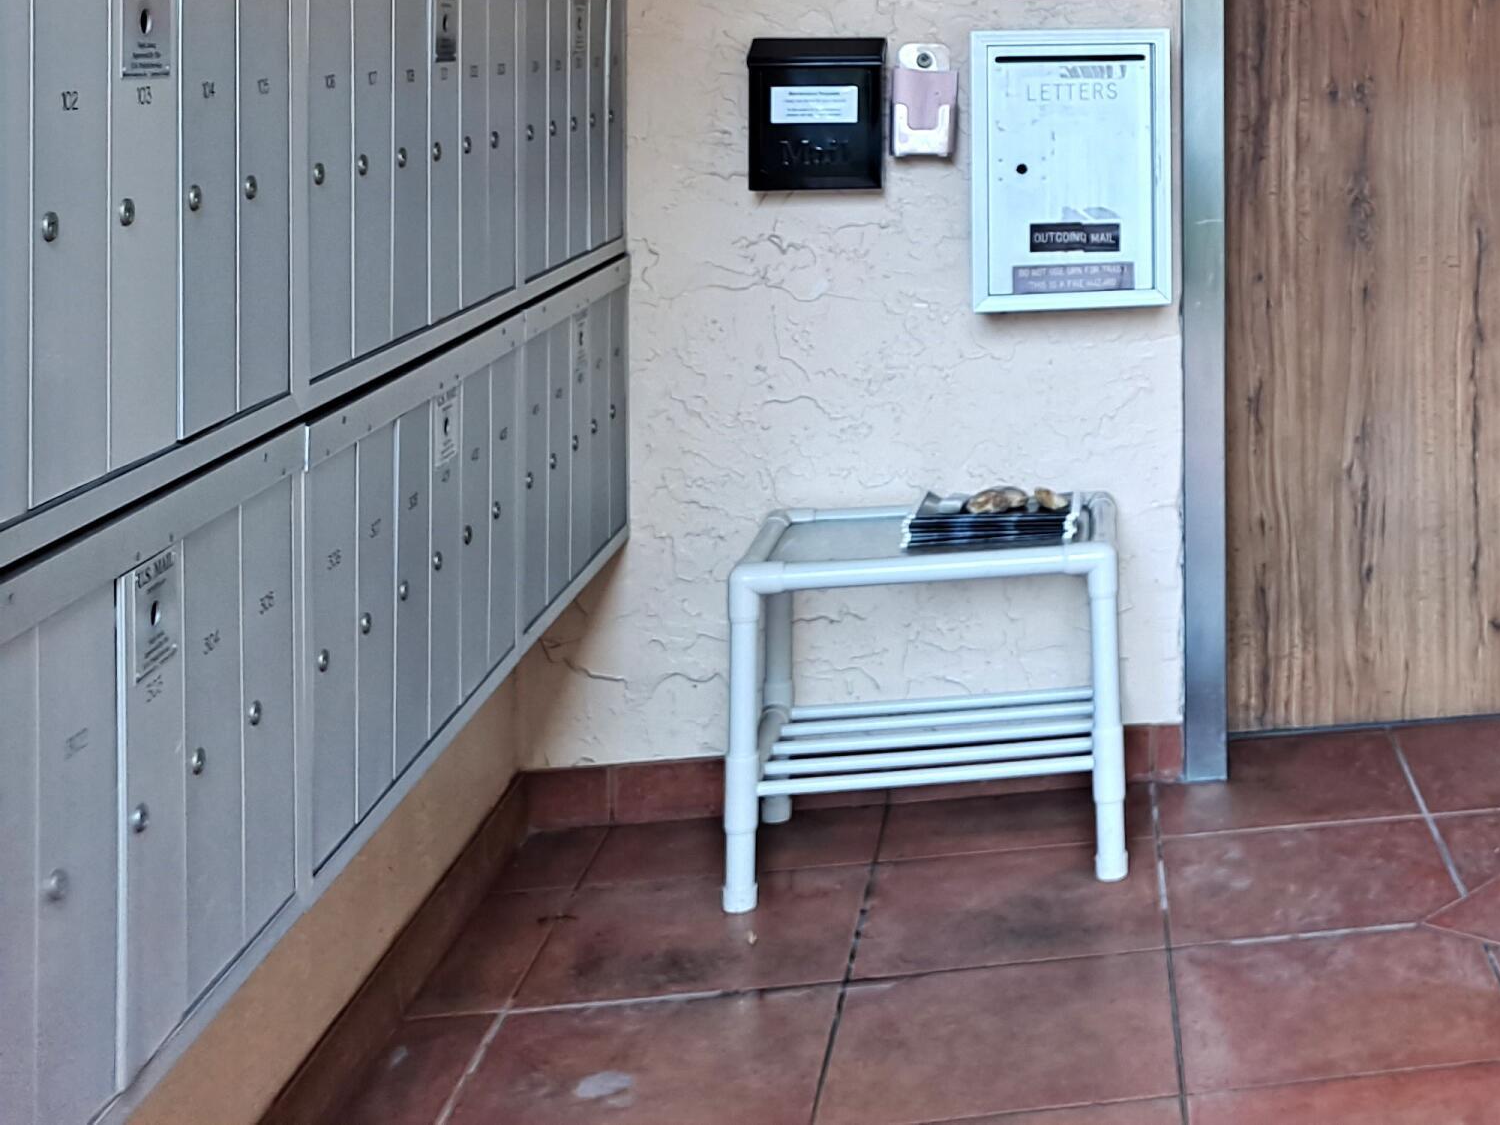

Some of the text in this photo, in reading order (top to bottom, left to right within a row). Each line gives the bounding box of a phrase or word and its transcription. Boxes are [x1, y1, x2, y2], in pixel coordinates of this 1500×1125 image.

[1026, 82, 1118, 102] LETTERS
[1033, 230, 1116, 244] OUTGOING MAIL
